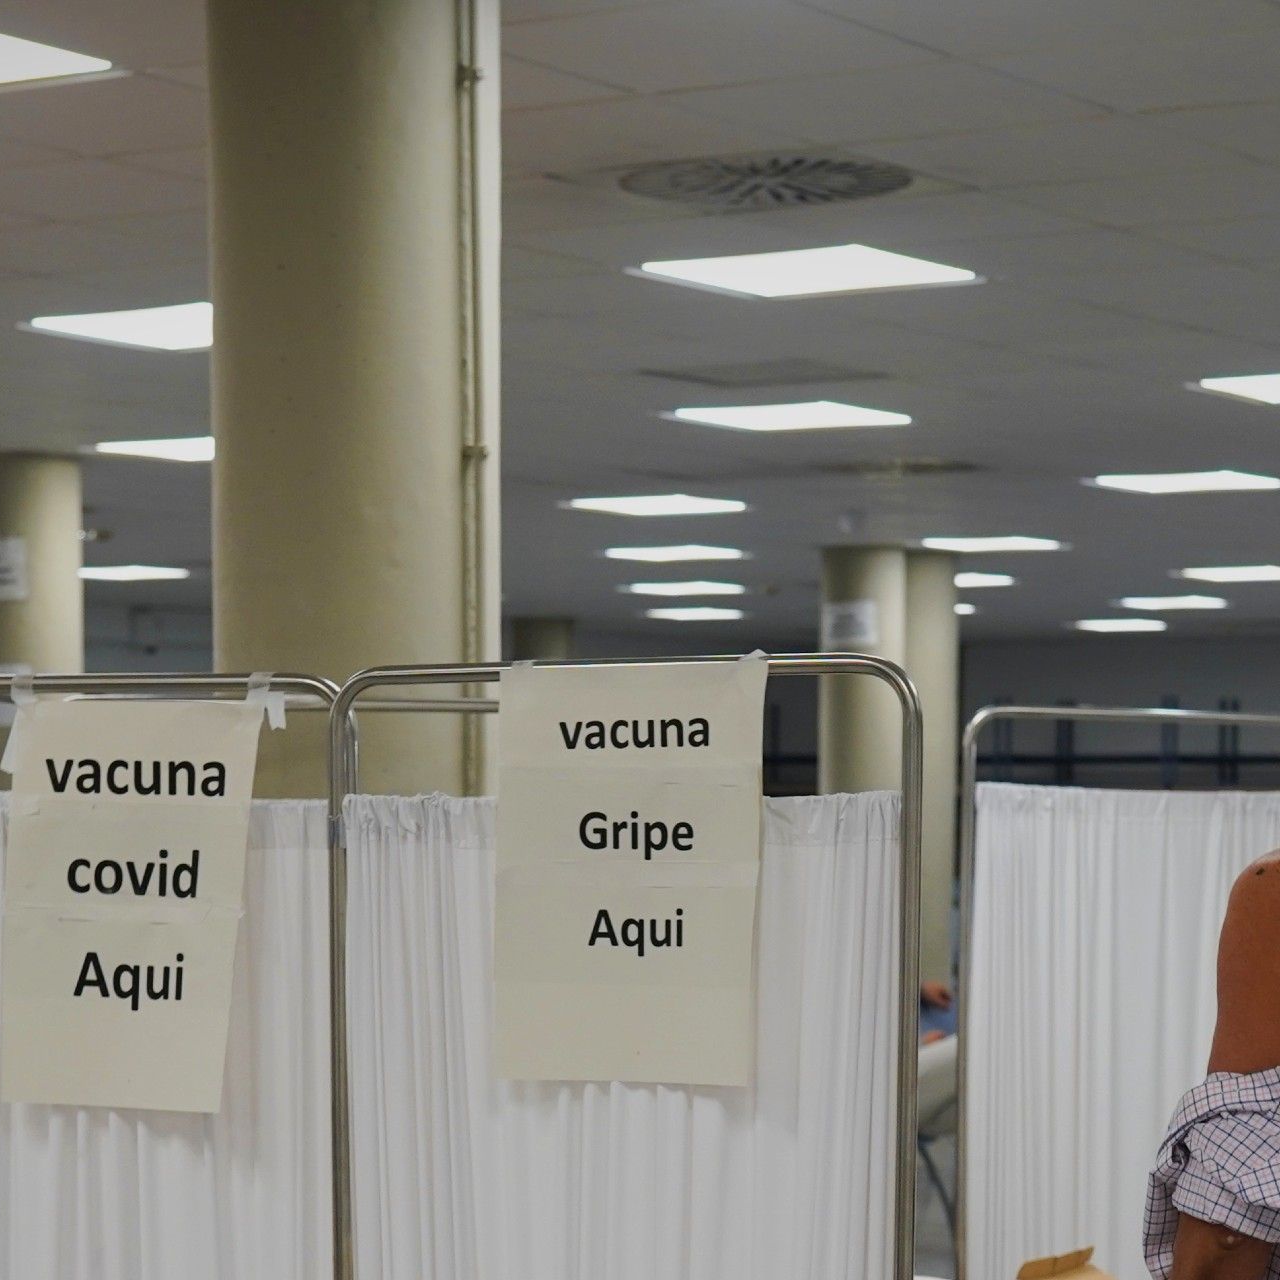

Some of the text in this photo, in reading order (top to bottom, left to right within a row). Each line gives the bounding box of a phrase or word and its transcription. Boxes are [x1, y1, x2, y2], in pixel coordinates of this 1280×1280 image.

[559, 717, 710, 750] vacuna
[45, 758, 226, 797] vacuna
[578, 810, 694, 860] Gripe
[67, 849, 200, 899] covid
[588, 907, 684, 957] Aqui
[73, 951, 185, 1012] Aqui
